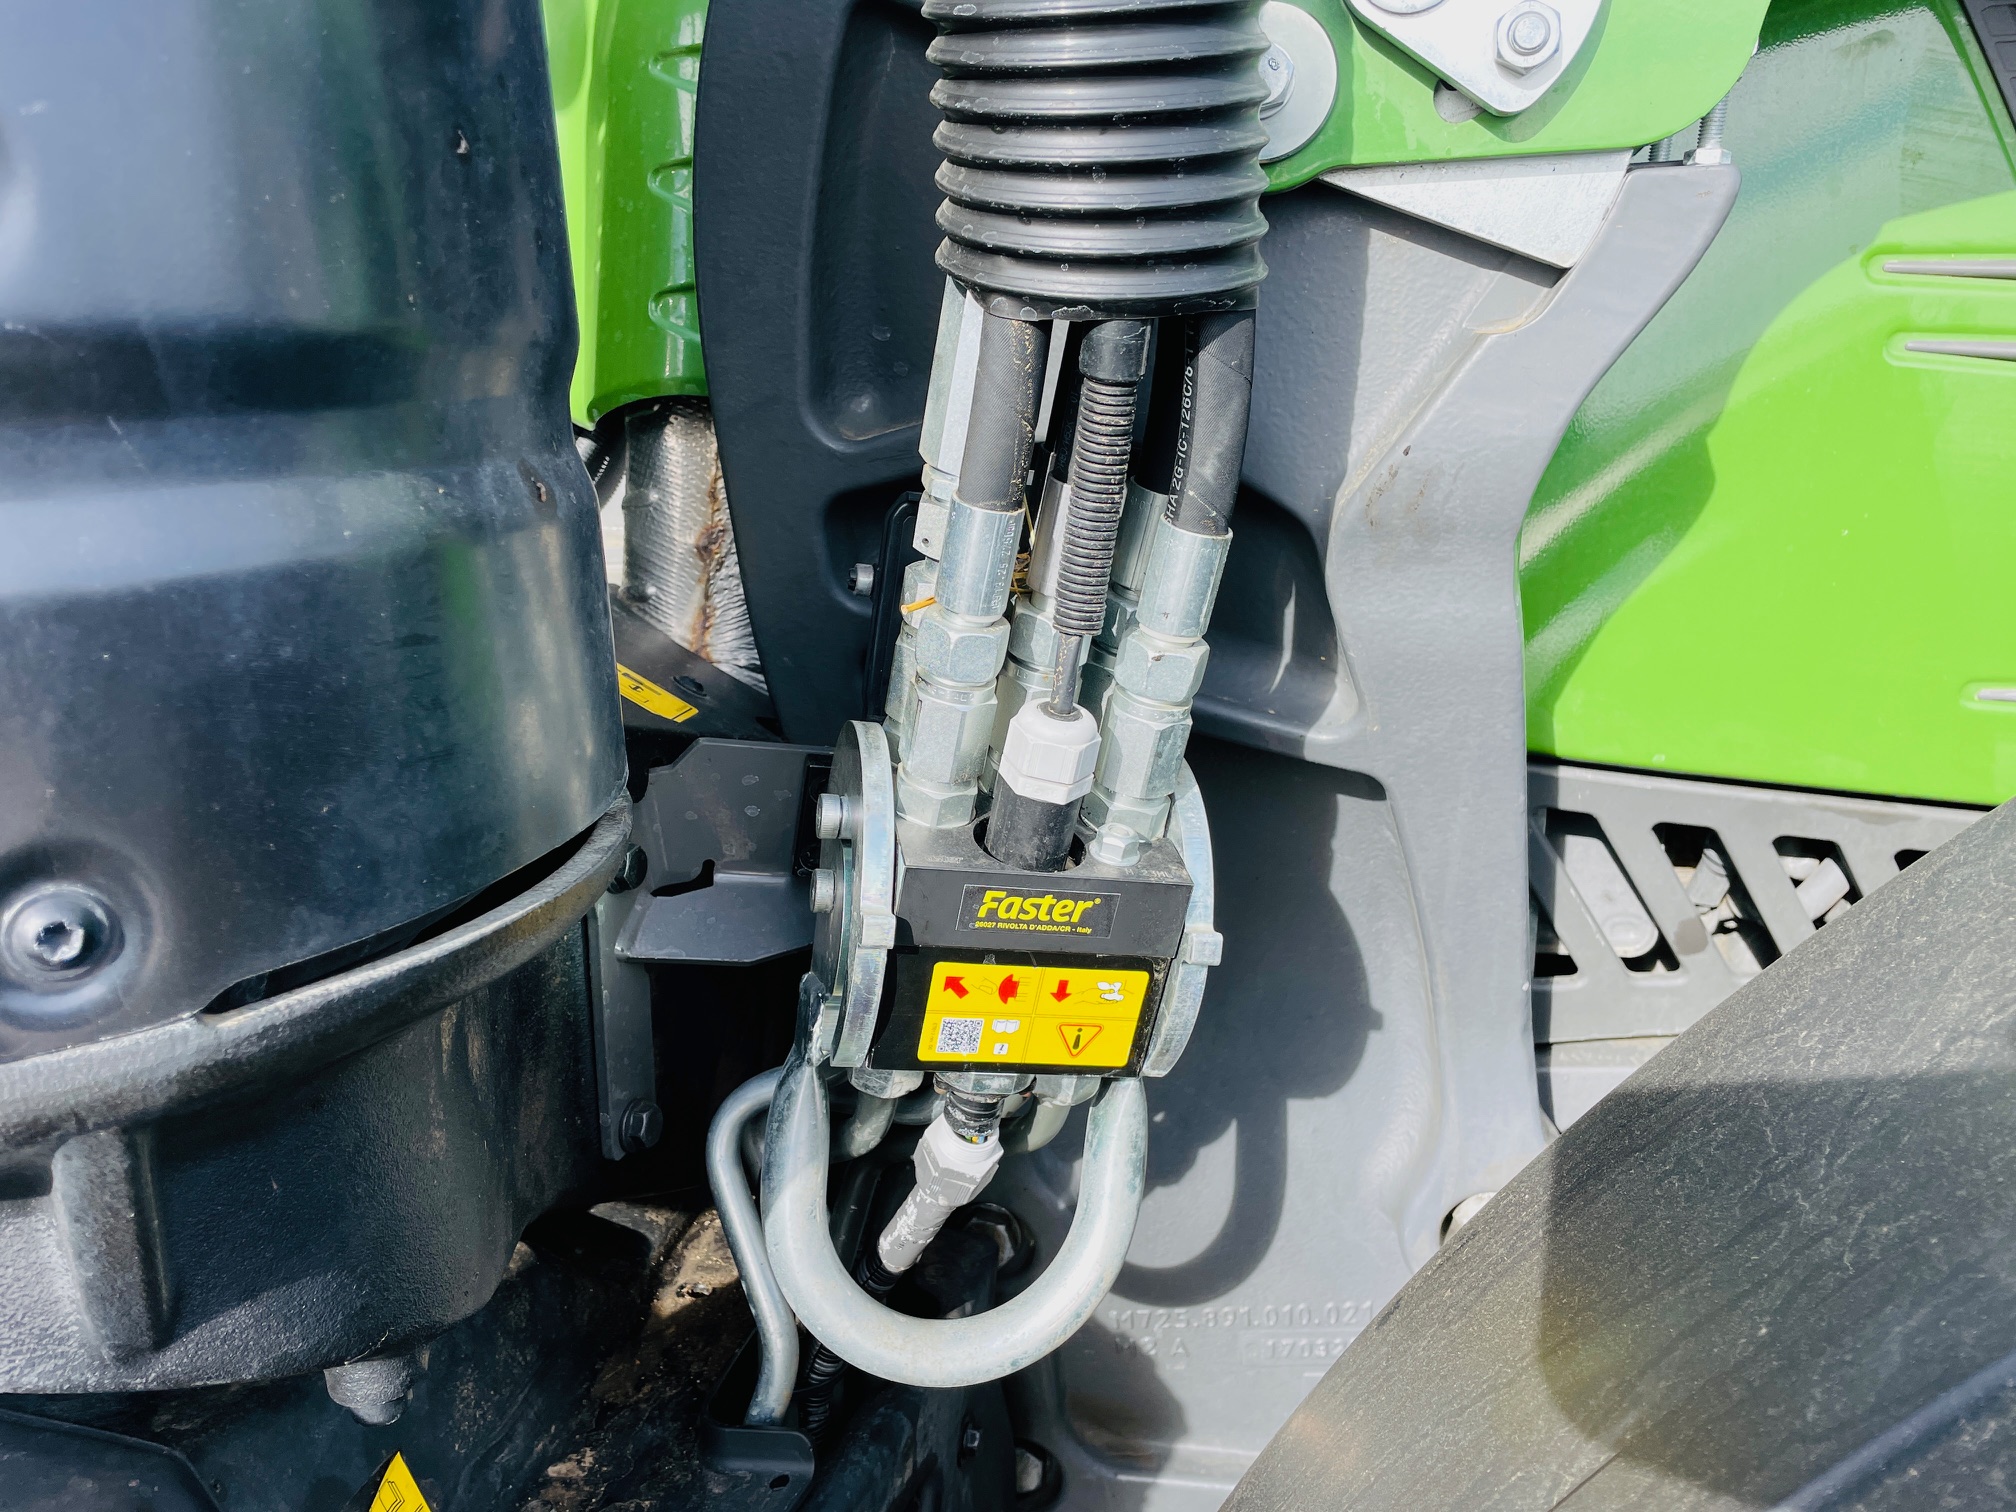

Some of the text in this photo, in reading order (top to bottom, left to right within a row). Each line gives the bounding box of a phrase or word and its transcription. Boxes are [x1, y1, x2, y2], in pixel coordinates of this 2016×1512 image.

[997, 922, 1028, 931] RIVOLTA
[1029, 923, 1072, 933] D'ADDA/CR
[1076, 926, 1093, 935] Italy
